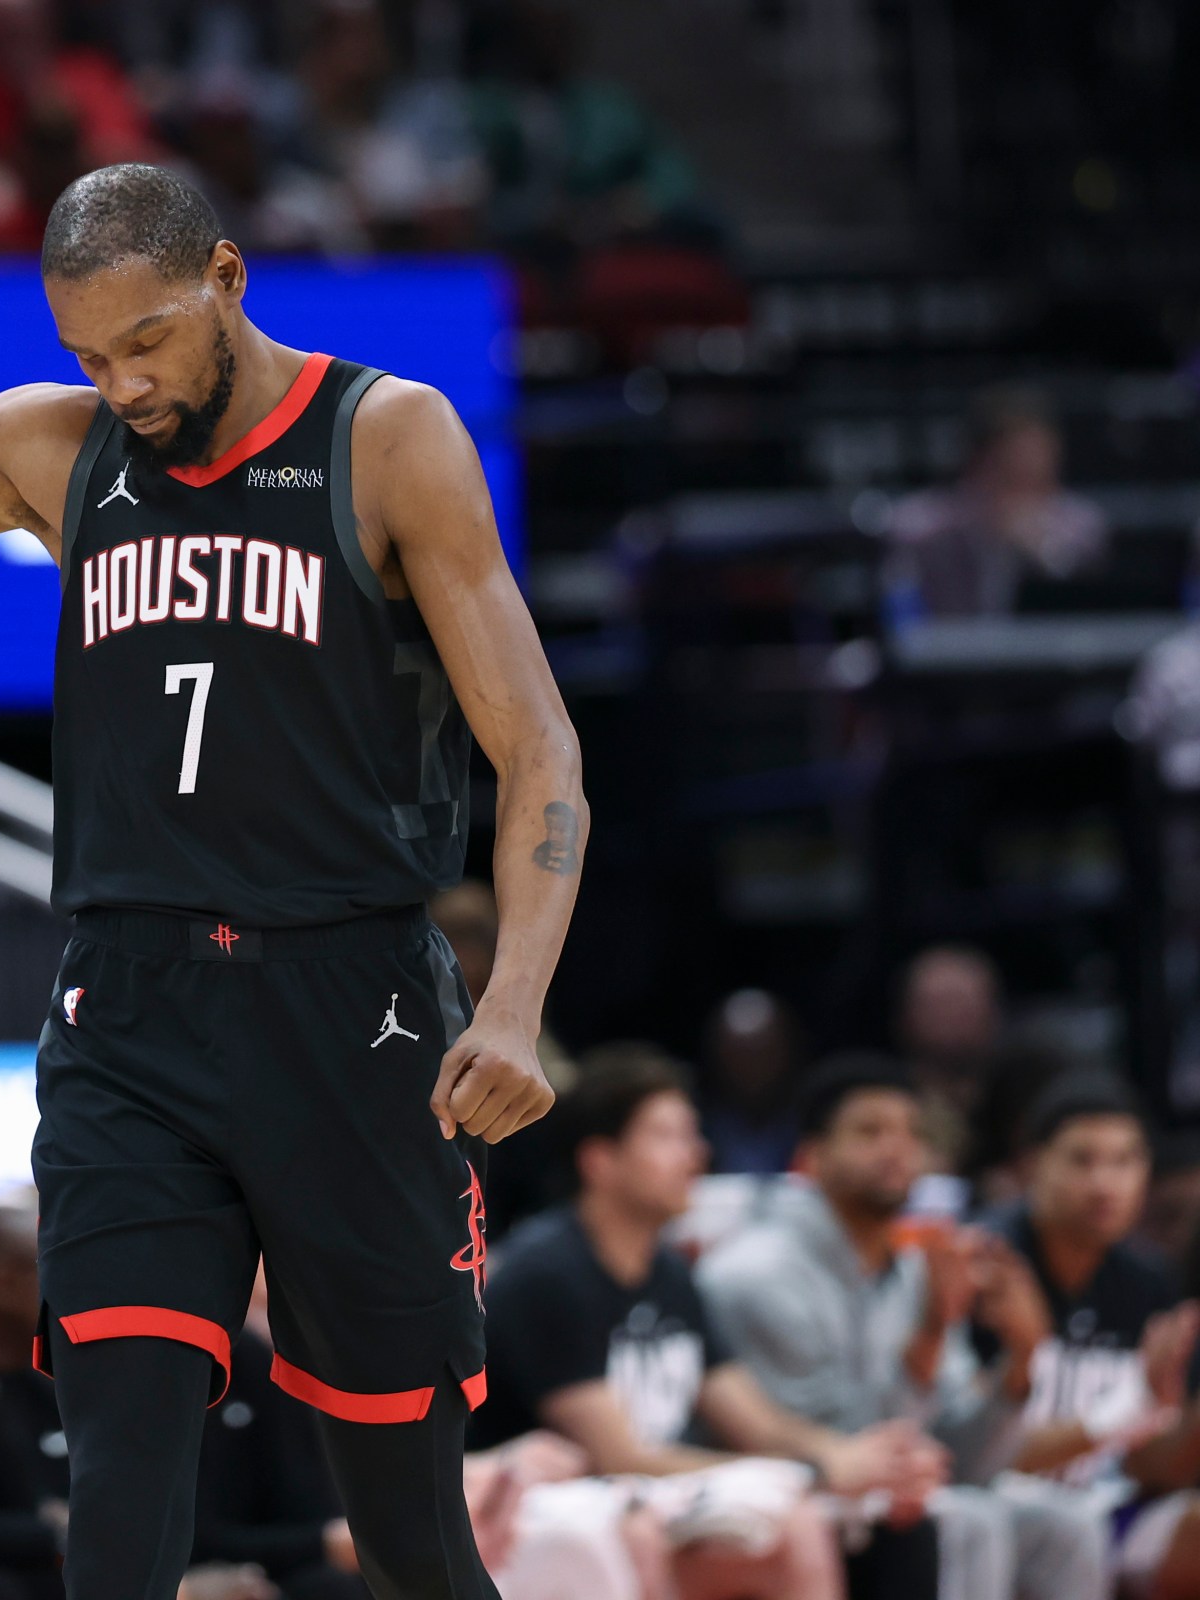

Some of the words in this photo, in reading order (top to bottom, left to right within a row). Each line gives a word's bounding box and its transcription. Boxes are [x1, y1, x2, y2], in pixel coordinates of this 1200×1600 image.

[247, 466, 325, 480] MEMORIAL
[247, 476, 324, 488] HERMANN
[82, 533, 326, 649] HOUSTON
[164, 662, 215, 794] 7
